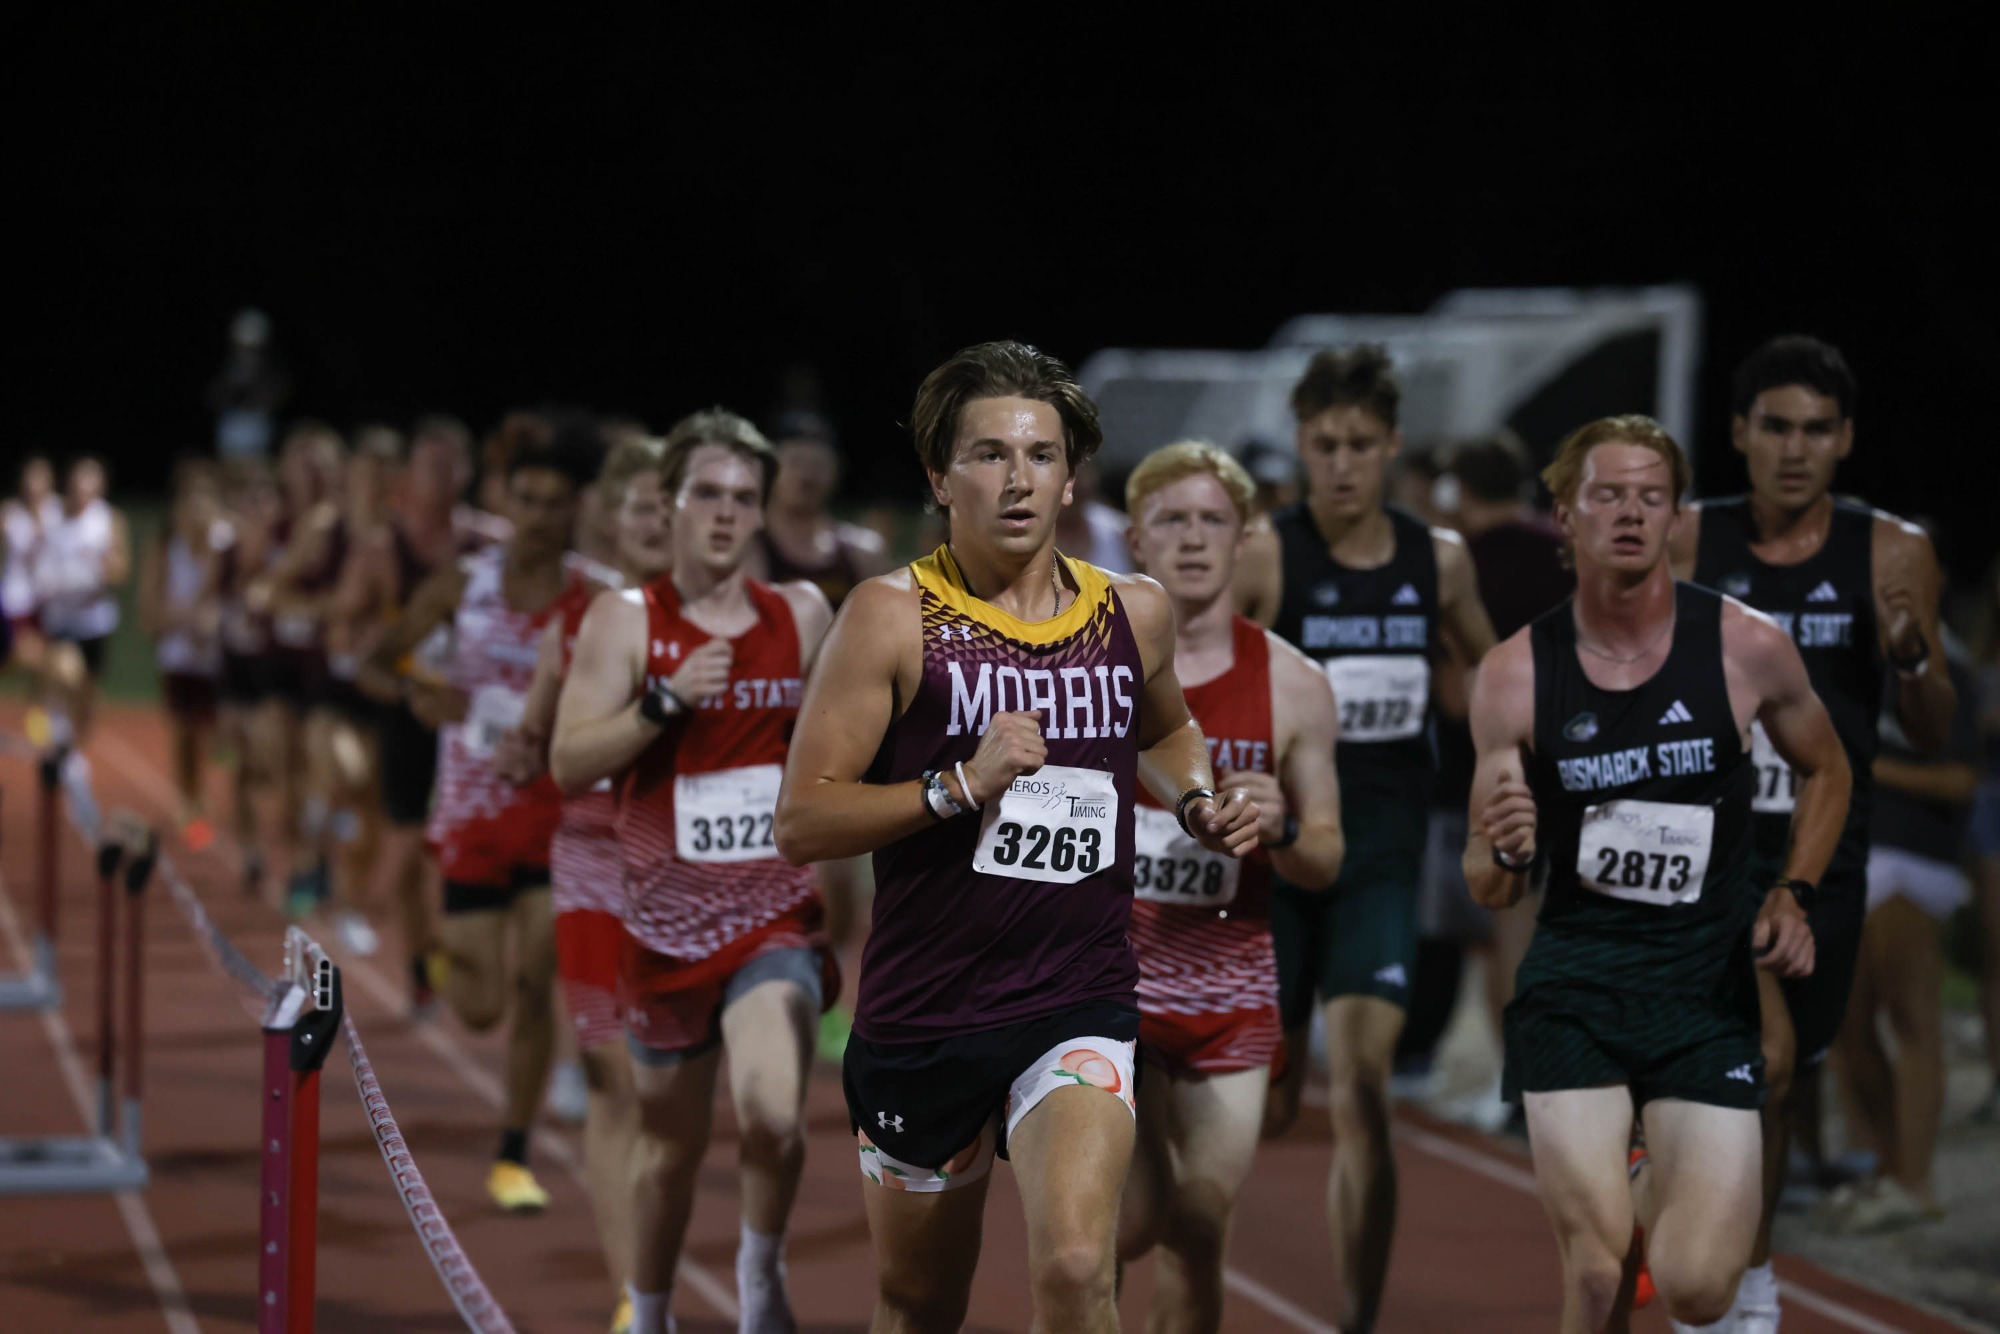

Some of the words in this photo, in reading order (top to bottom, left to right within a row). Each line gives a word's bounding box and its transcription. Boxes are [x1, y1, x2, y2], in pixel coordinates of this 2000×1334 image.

[947, 661, 1134, 739] MORRIS
[1205, 738, 1268, 771] TATE
[1557, 746, 1651, 792] BISMARCK
[1656, 738, 1716, 777] STATE
[1009, 780, 1050, 795] ERO'S
[692, 812, 774, 852] 3322
[993, 822, 1101, 873] 3263
[1135, 855, 1224, 896] 3328
[1596, 847, 1691, 892] 2873
